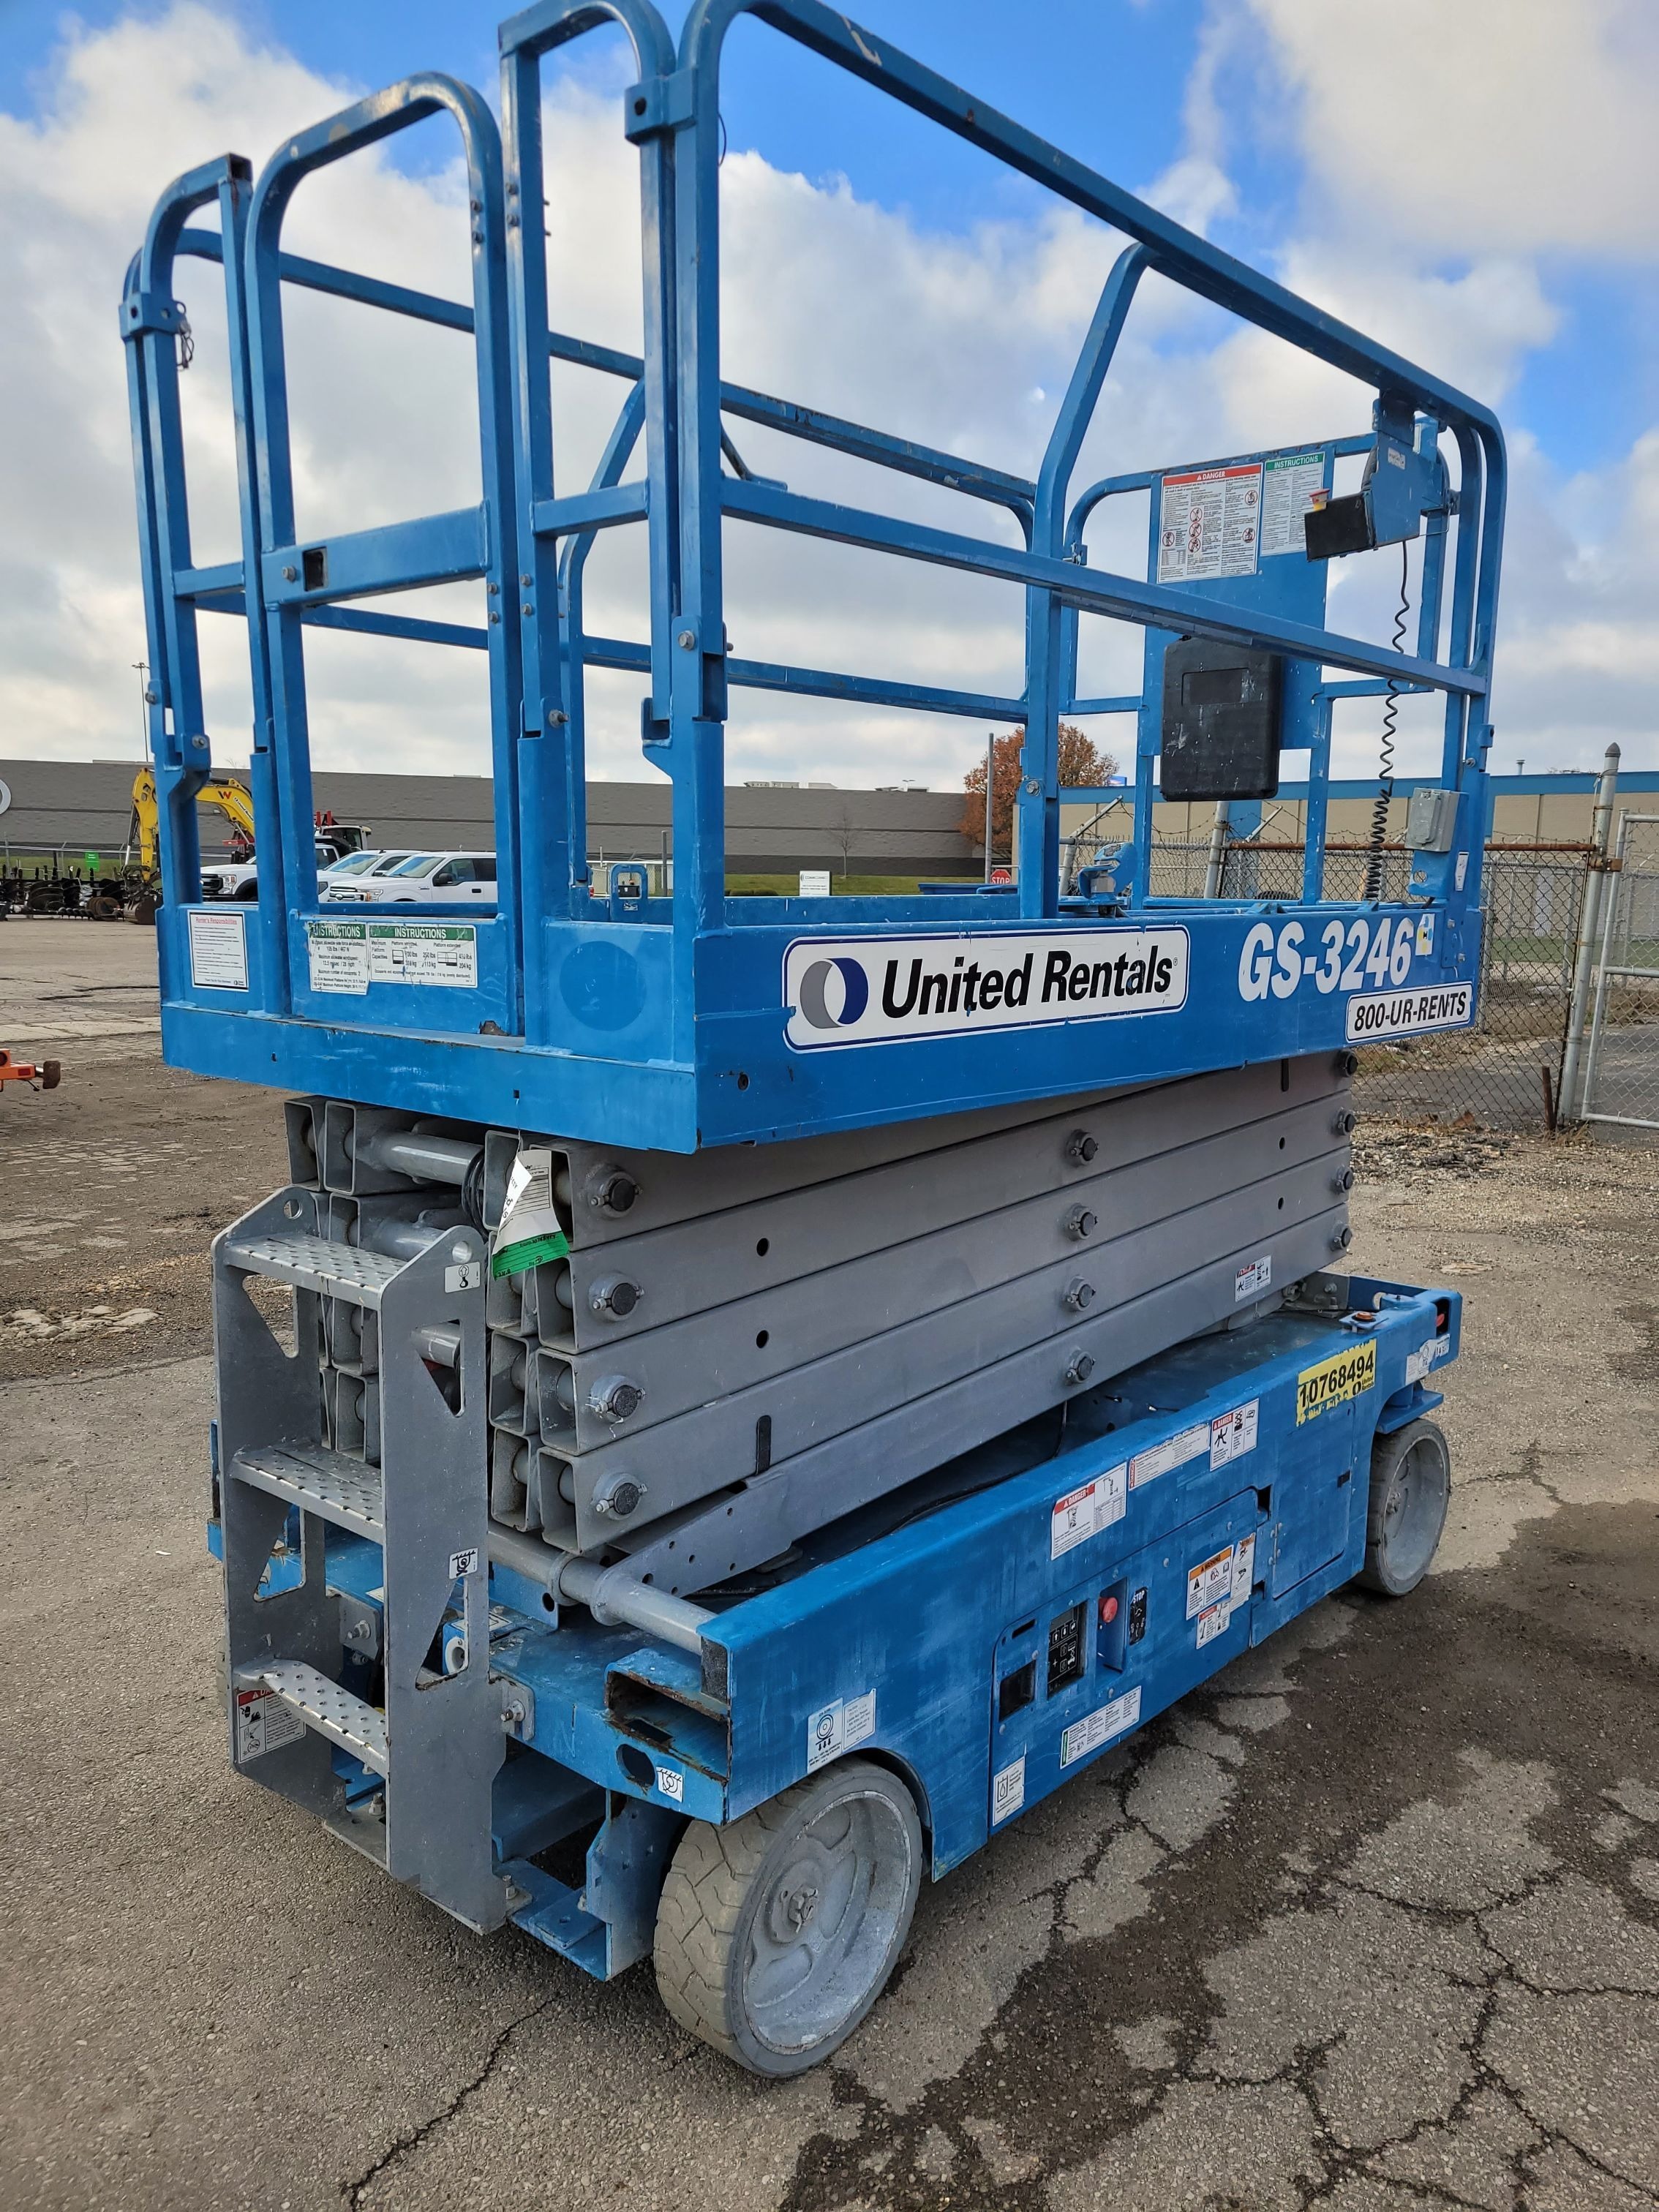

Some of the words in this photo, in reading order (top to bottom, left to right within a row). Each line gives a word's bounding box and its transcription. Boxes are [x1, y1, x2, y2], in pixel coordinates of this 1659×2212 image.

[1274, 455, 1318, 468] INSTRUCTIONS
[1203, 471, 1225, 480] DANGER
[395, 928, 446, 938] INSTRUCTIONS
[1238, 917, 1414, 1001] GS-3246
[881, 952, 1034, 1018] United
[1354, 991, 1467, 1031] 800-UR-RENTS
[1300, 1350, 1374, 1408] 10768494
[1068, 1489, 1087, 1506] DANGER
[1132, 1590, 1145, 1604] STOP
